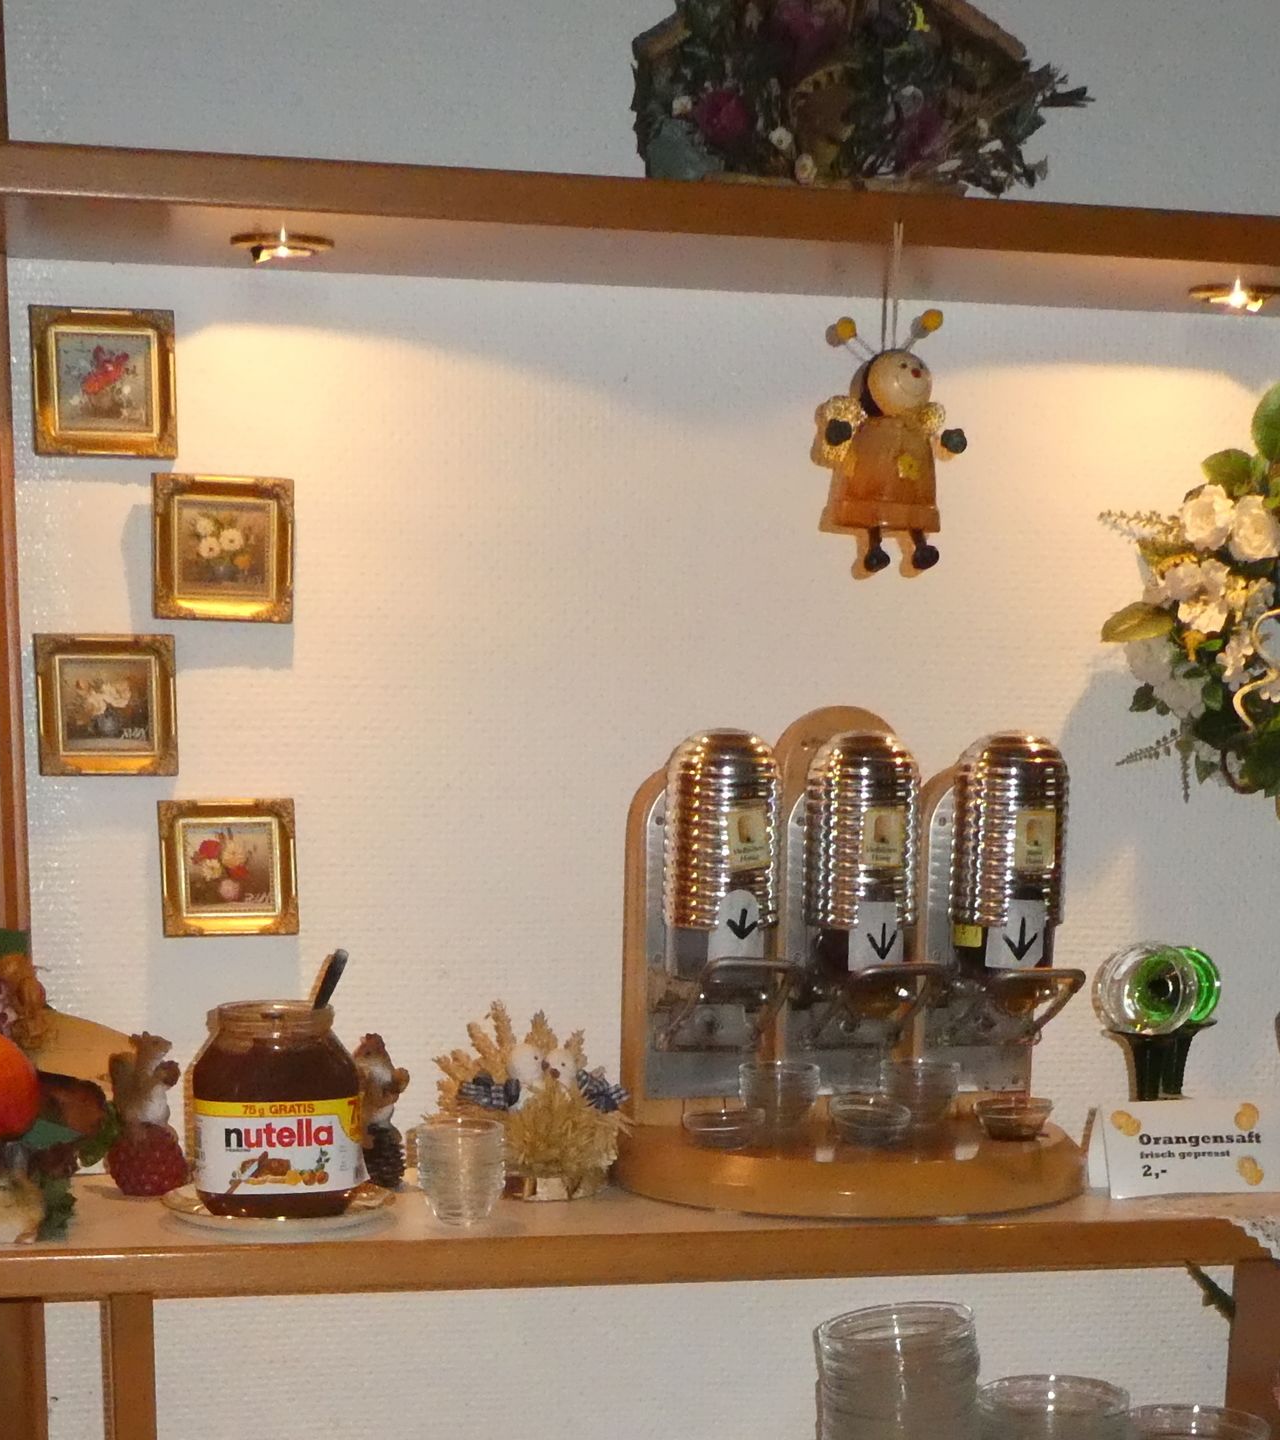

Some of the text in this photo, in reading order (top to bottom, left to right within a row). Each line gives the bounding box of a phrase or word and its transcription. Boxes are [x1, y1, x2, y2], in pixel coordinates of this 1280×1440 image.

[269, 1103, 316, 1114] GRATIS
[224, 1118, 334, 1148] nutella
[1139, 1131, 1262, 1147] Orangensaft
[1139, 1150, 1175, 1159] frisch
